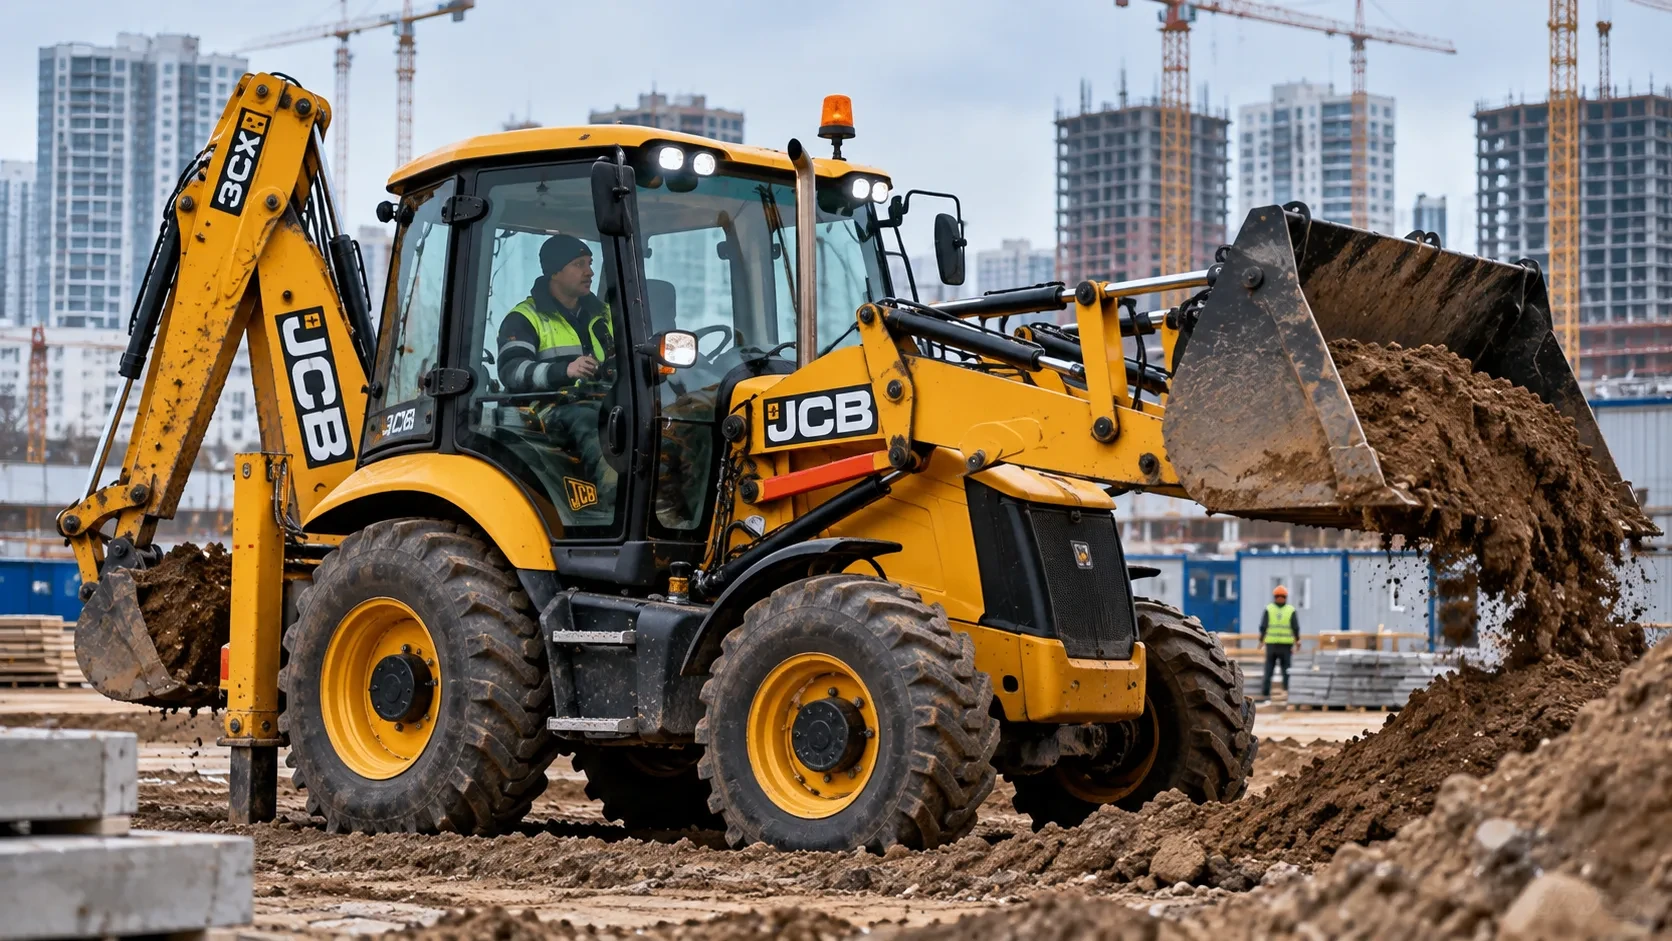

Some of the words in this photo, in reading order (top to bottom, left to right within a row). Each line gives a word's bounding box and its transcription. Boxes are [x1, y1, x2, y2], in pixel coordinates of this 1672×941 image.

[218, 130, 261, 208] 3CX
[282, 316, 348, 461] JCB
[767, 390, 873, 442] JCB
[568, 480, 596, 509] JCB
